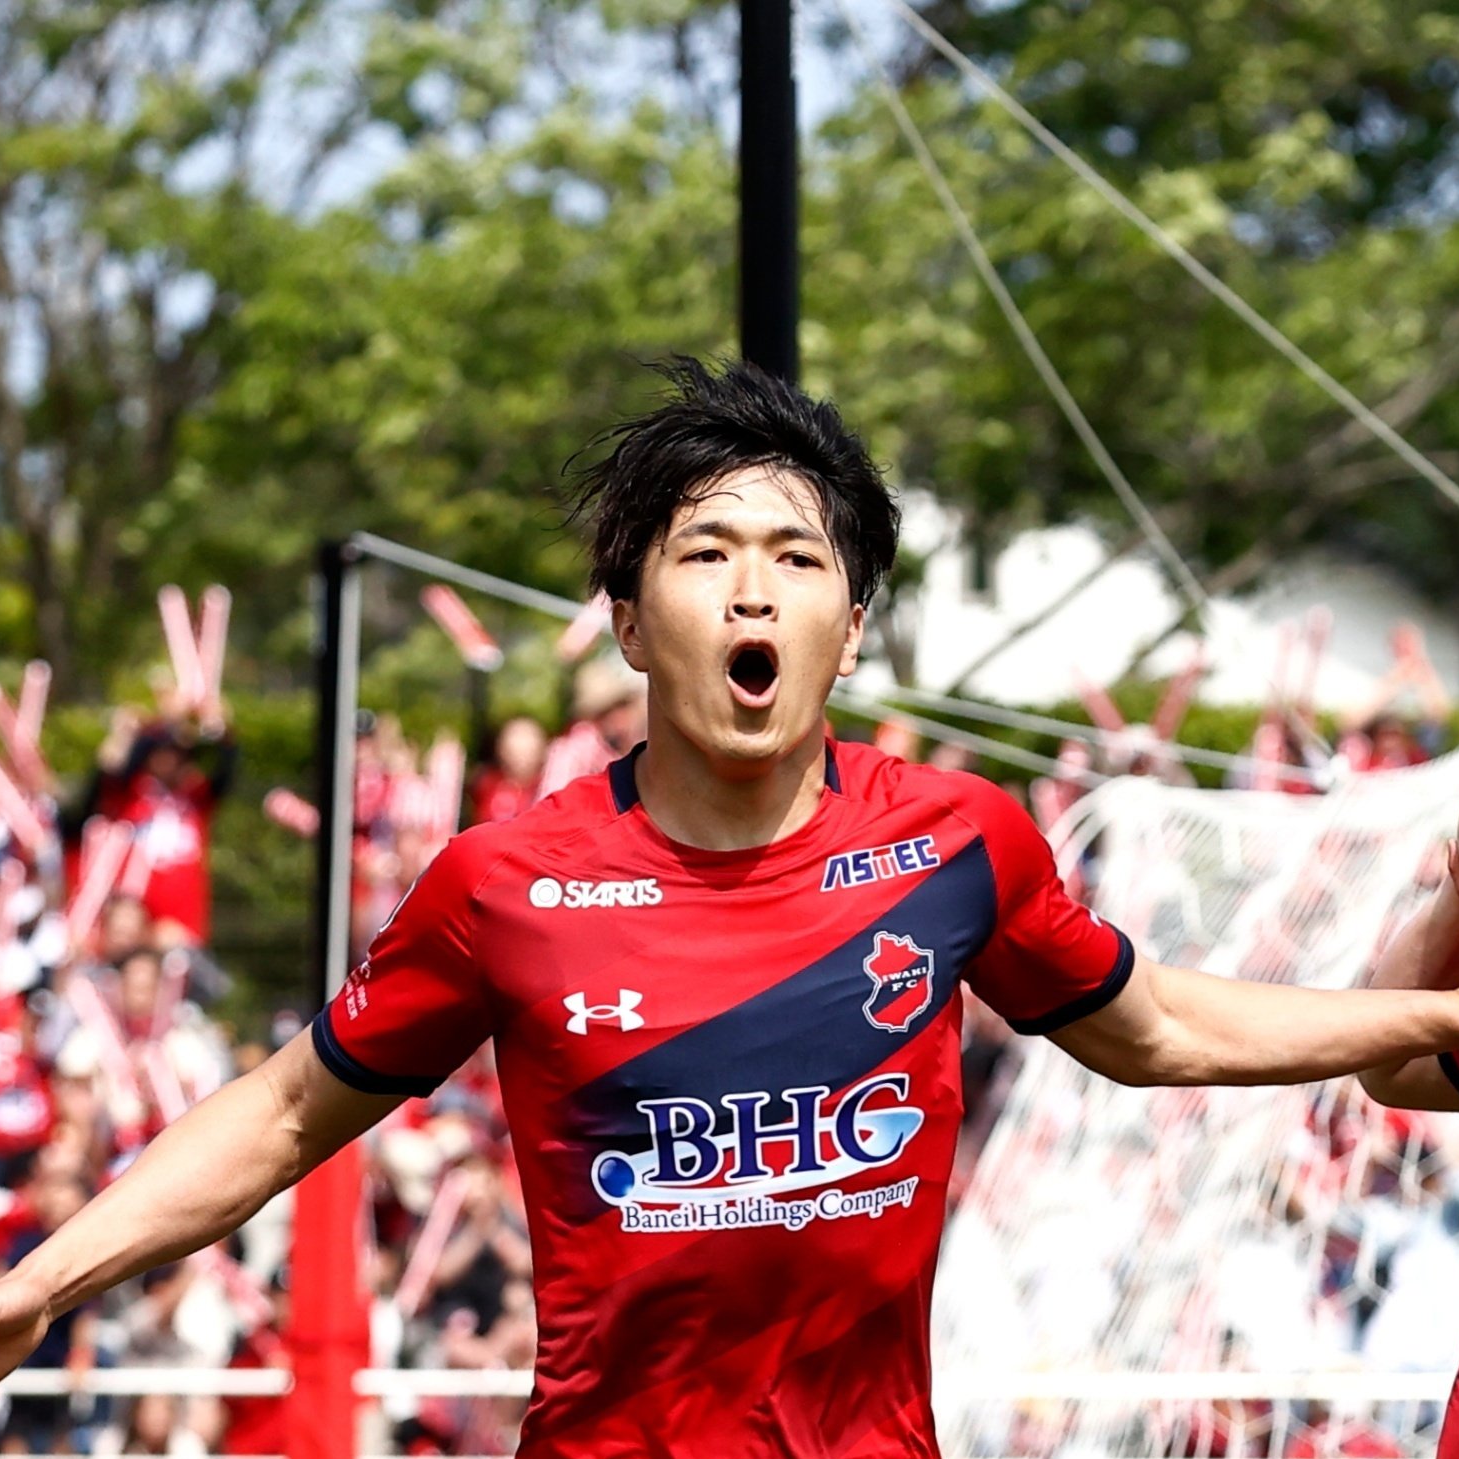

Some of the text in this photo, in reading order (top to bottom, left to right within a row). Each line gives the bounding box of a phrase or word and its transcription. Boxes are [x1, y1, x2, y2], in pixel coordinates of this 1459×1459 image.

[821, 835, 940, 891] ASTEC
[563, 878, 663, 908] STARTS
[882, 966, 928, 983] IWAKI
[639, 1075, 908, 1184] BHC
[624, 1179, 918, 1229] Banei Holdings Company
